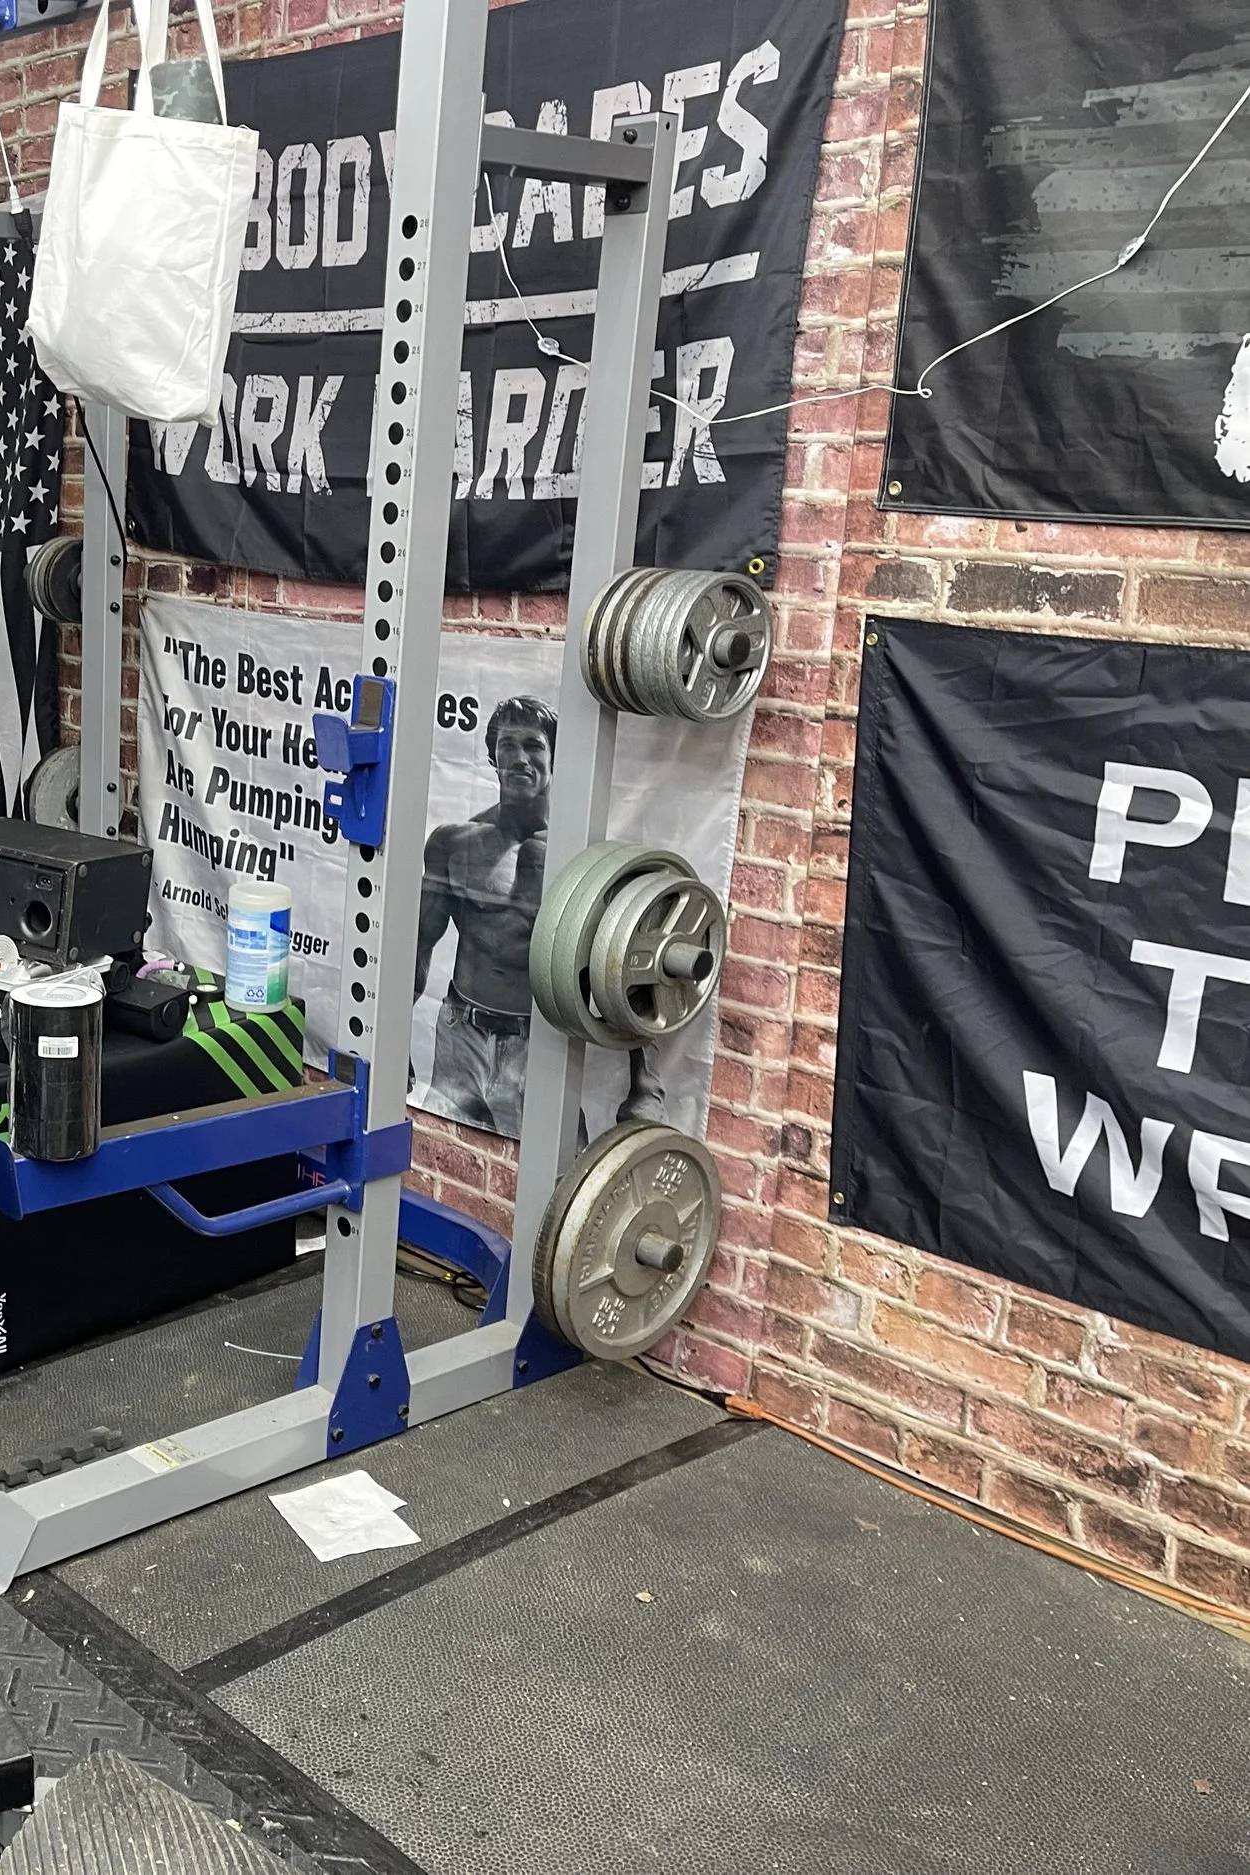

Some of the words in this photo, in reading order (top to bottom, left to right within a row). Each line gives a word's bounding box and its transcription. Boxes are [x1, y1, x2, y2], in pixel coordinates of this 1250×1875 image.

[237, 652, 303, 705] Best
[211, 706, 272, 759] Your
[165, 749, 194, 799] Are
[204, 766, 339, 844] Pumping
[161, 879, 212, 912] Arnold
[368, 955, 378, 965] 09
[364, 1025, 373, 1035] 07
